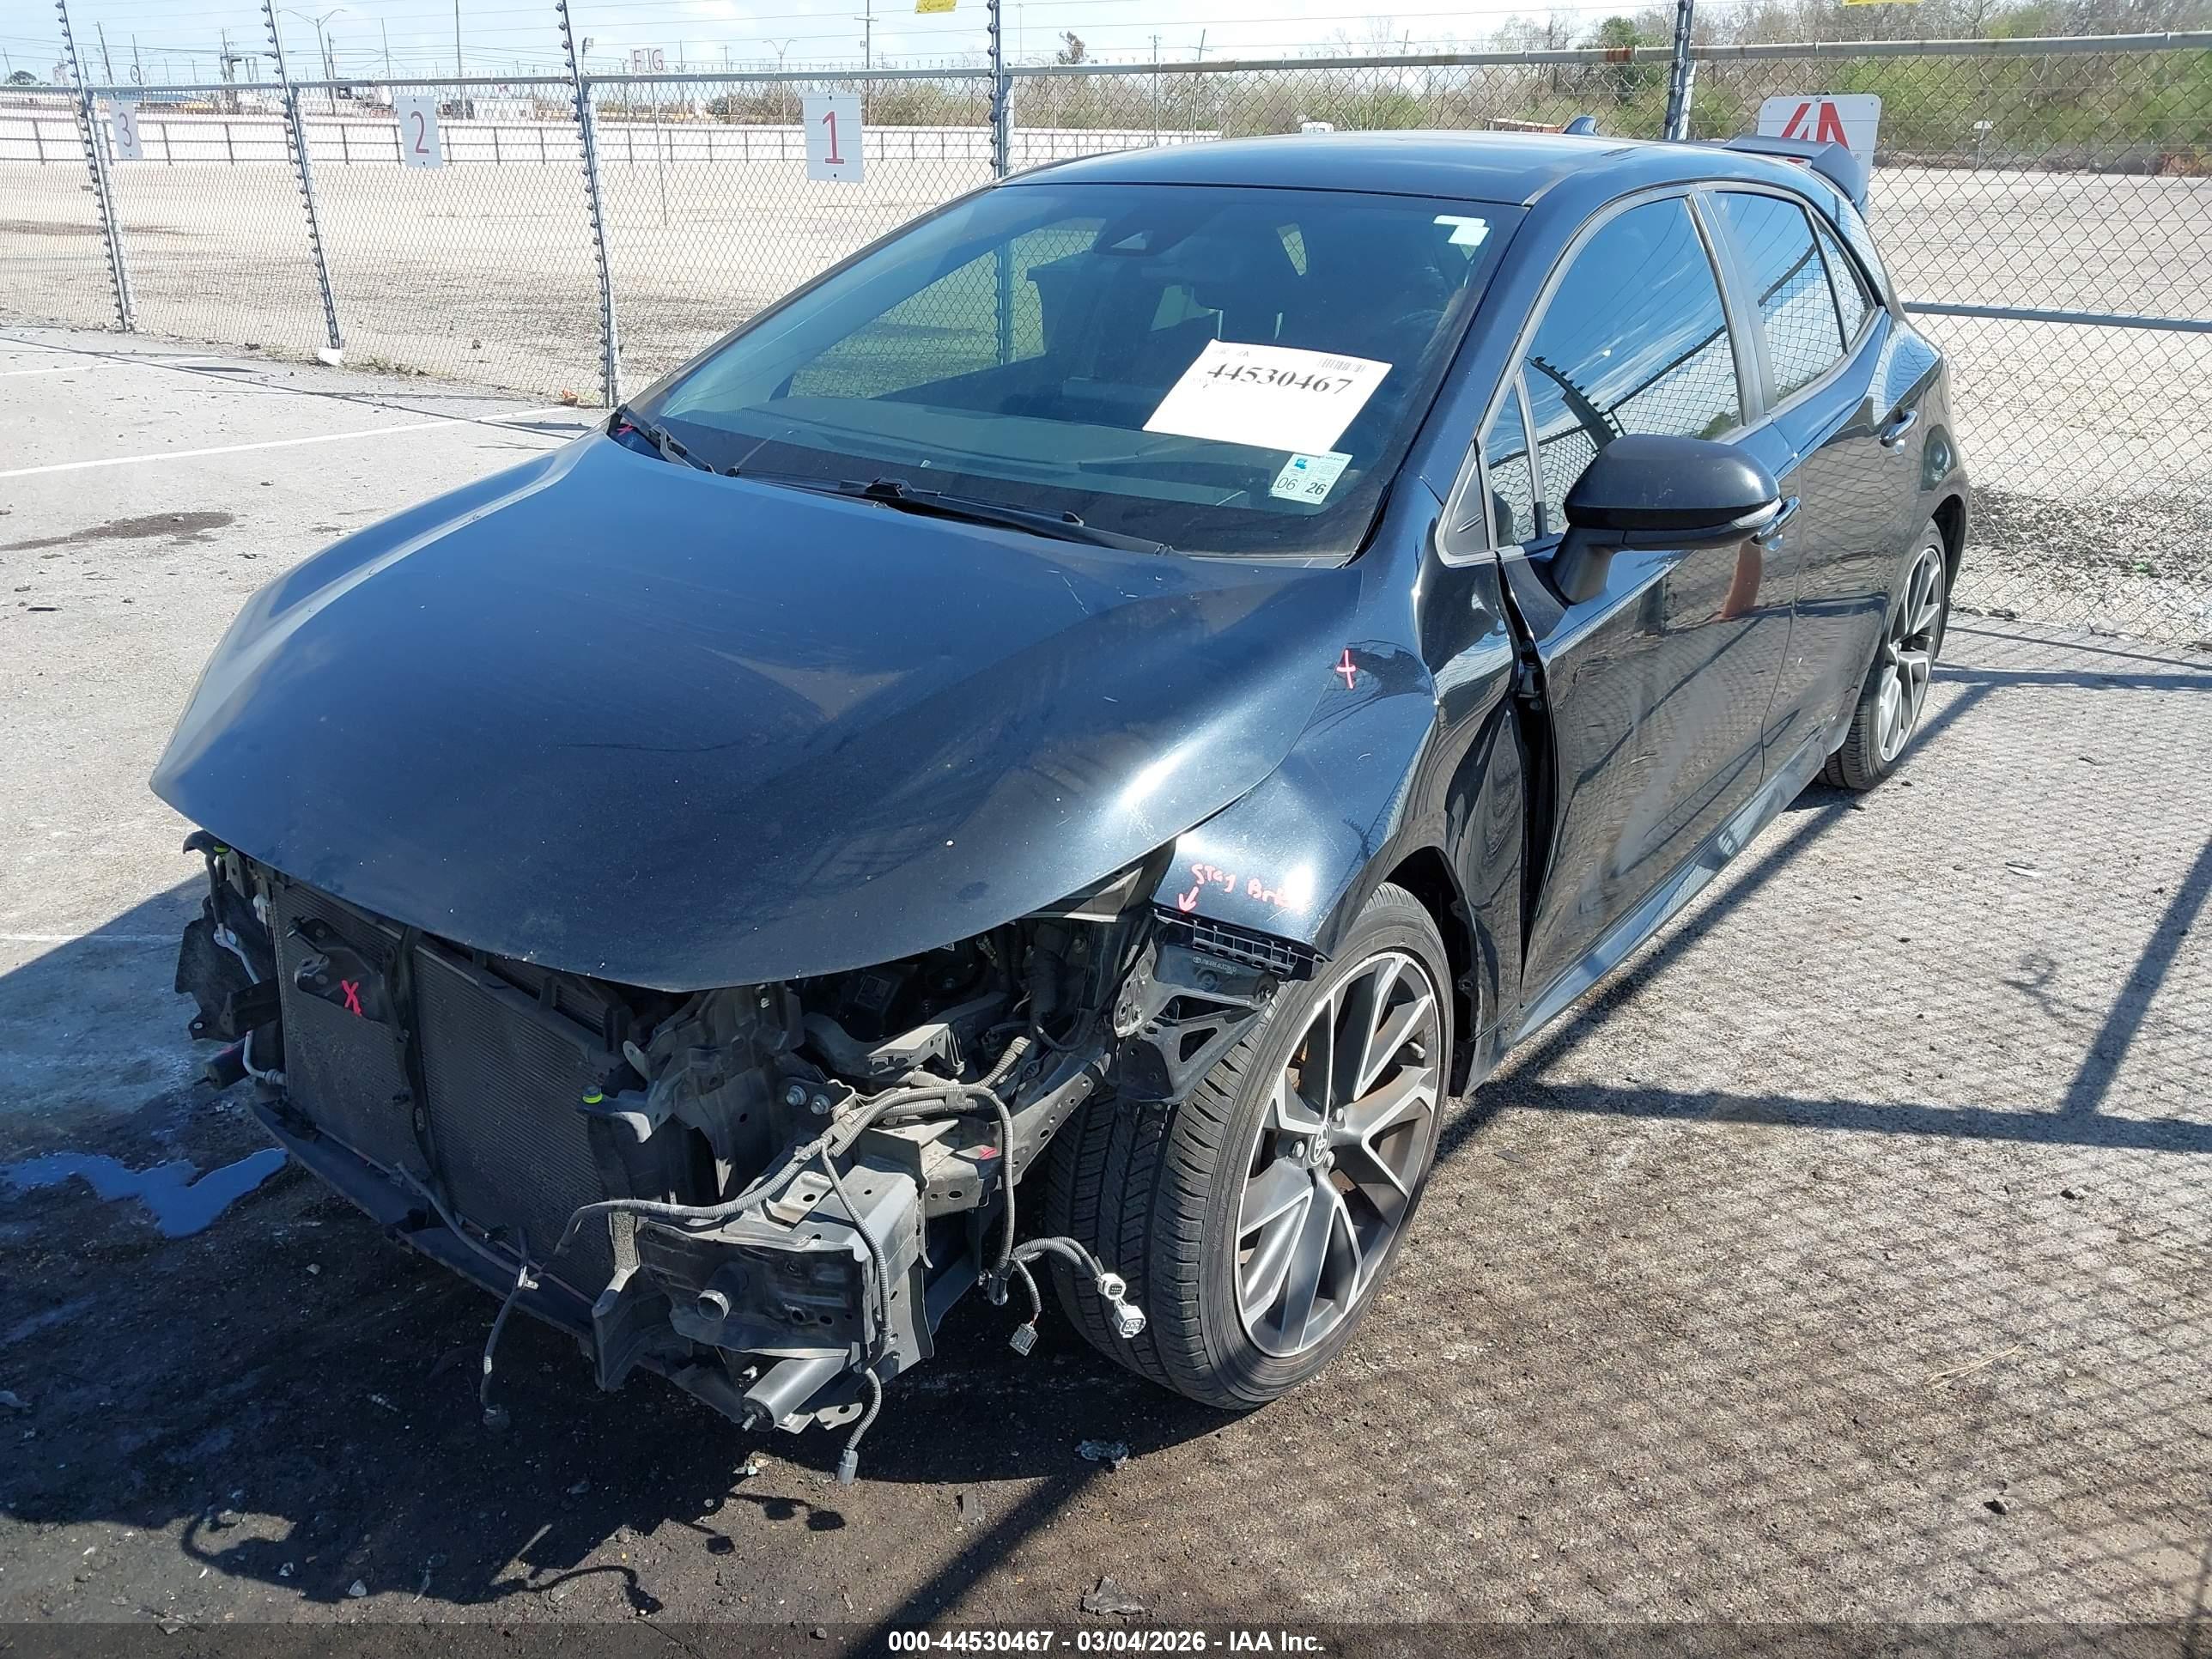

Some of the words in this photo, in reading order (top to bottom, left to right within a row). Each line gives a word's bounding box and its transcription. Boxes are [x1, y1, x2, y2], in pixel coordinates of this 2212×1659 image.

[118, 112, 132, 147] 3
[410, 111, 430, 154] 2
[822, 111, 845, 164] 1
[1206, 362, 1354, 395] 44530467
[1276, 477, 1299, 490] 06
[1305, 482, 1327, 495] 26
